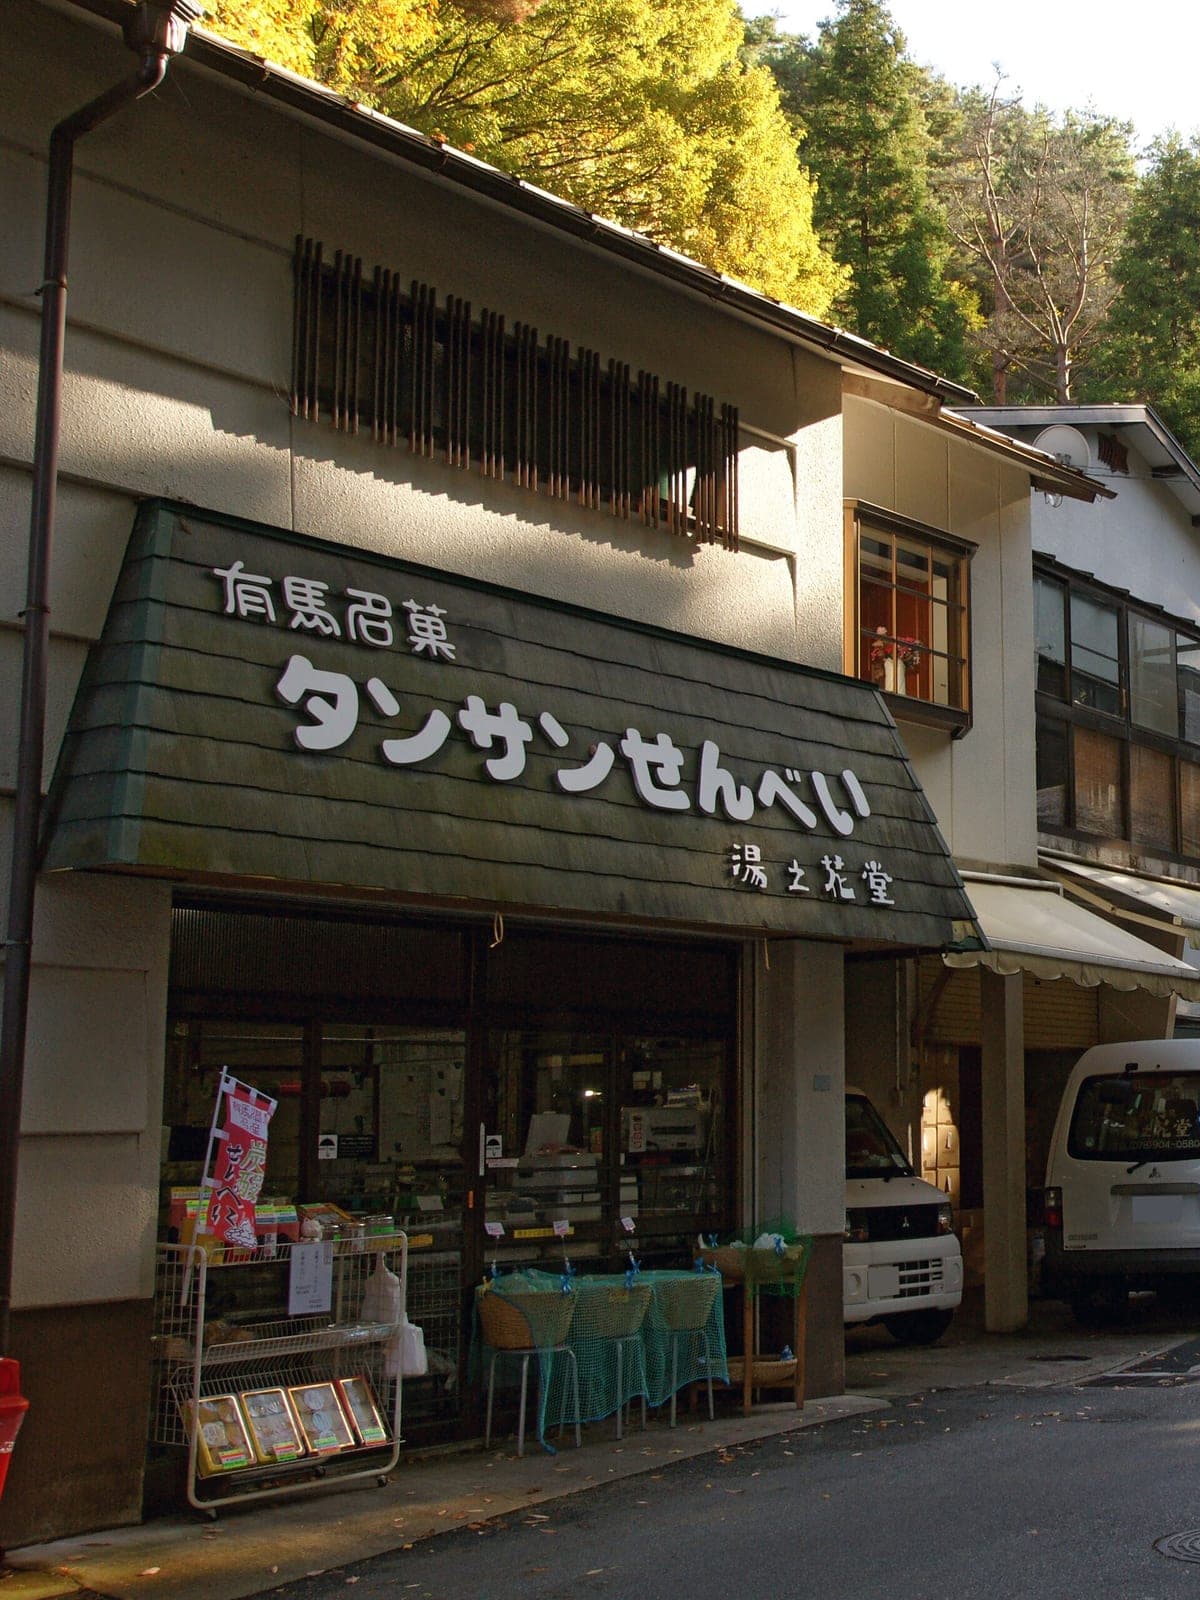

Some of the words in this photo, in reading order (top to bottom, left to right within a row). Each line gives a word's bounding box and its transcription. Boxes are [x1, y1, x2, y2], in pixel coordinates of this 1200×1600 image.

[213, 560, 456, 661] 有馬名菓
[275, 653, 872, 838] タンサンせんべい
[731, 843, 896, 905] 湯之花堂
[235, 1139, 267, 1204] 炭酸
